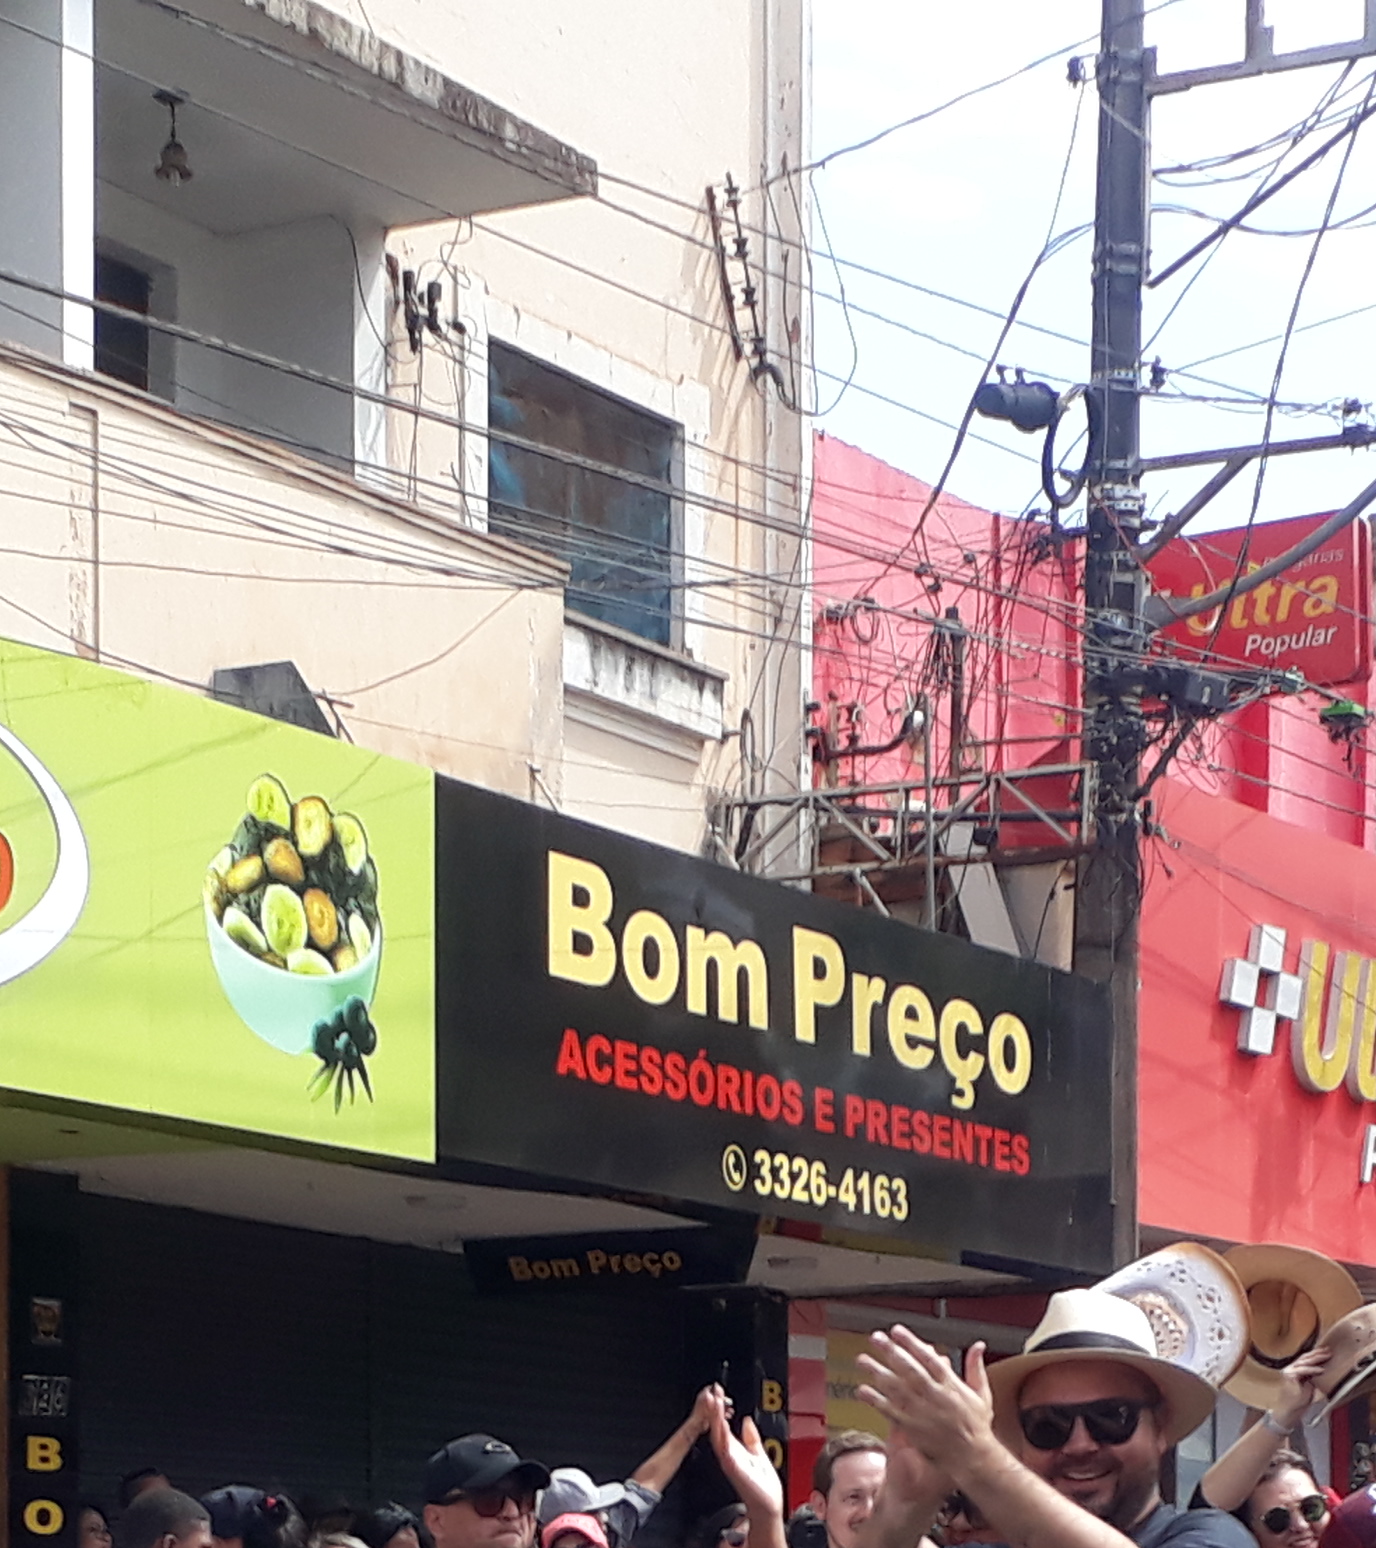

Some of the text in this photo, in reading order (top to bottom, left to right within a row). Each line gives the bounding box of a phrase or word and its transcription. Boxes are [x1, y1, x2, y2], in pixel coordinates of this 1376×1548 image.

[1245, 624, 1337, 657] Popular
[547, 850, 1033, 1110] Bom Preço
[555, 1028, 1031, 1175] ACESSÓRIOS E PRESENTES
[753, 1149, 910, 1222] 3326-4163
[508, 1249, 683, 1281] Bom Preço
